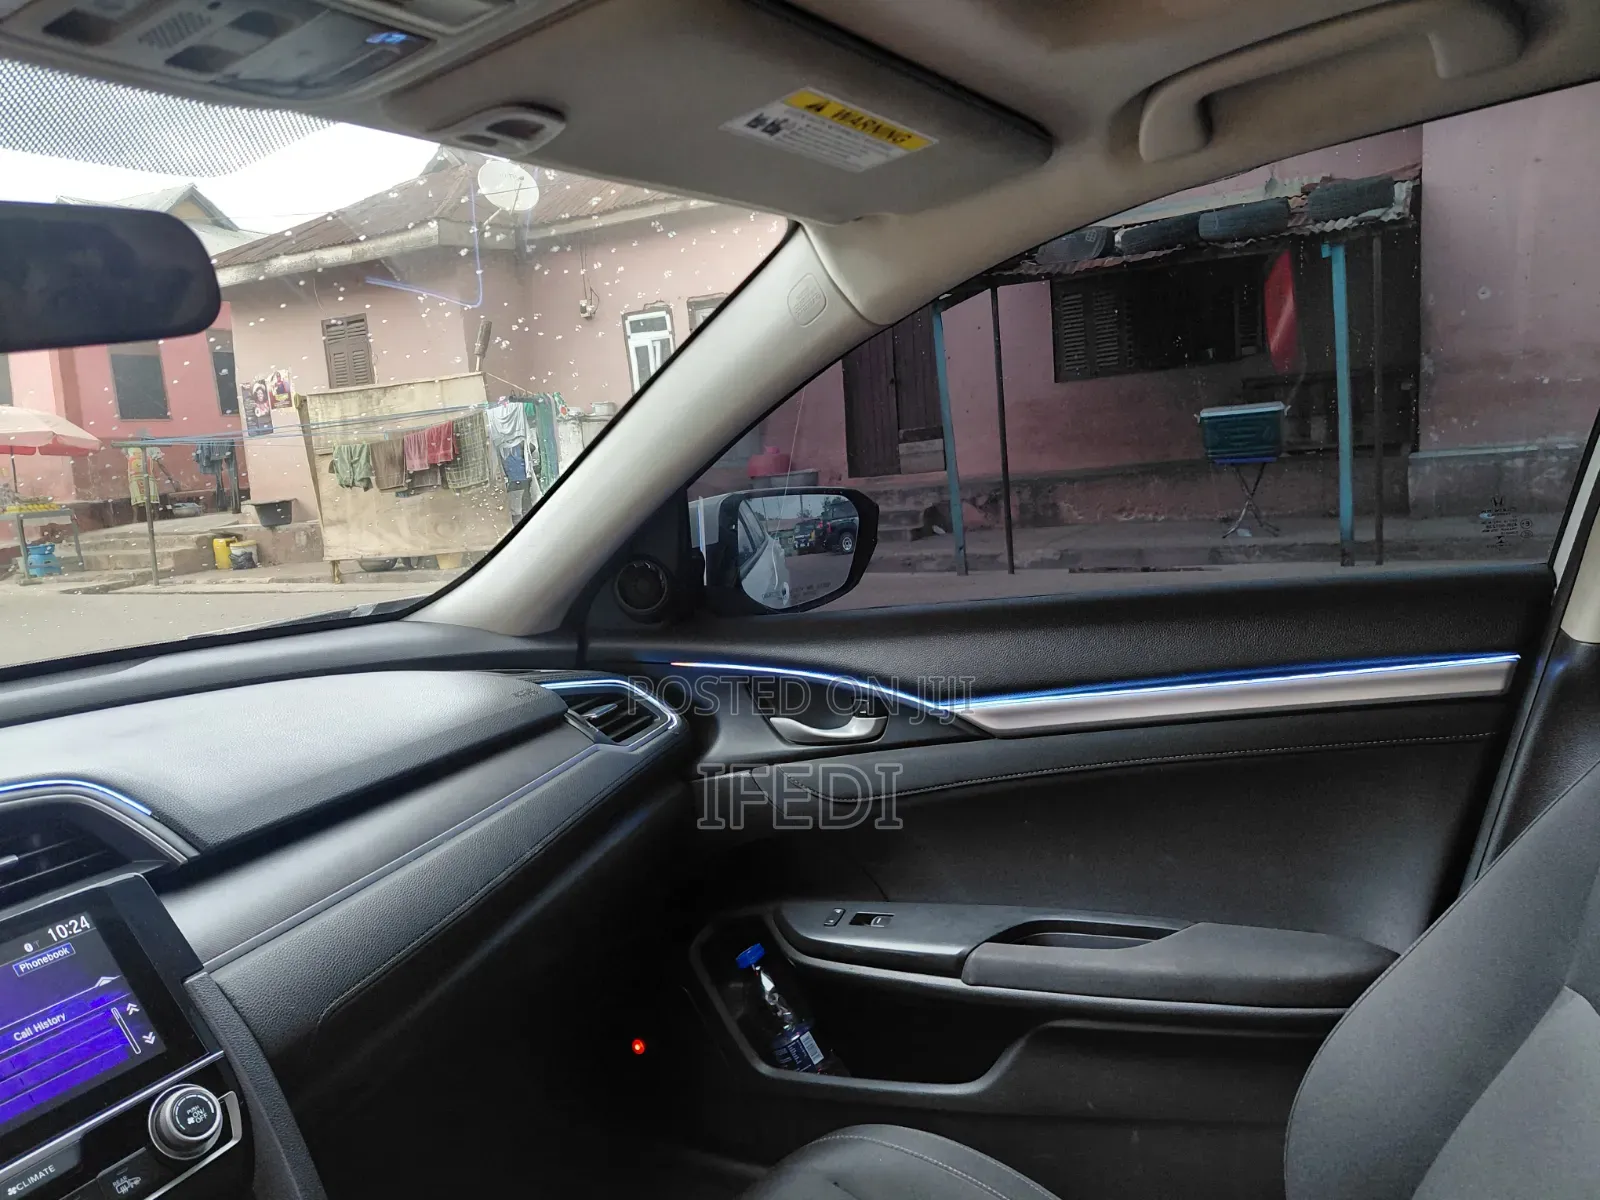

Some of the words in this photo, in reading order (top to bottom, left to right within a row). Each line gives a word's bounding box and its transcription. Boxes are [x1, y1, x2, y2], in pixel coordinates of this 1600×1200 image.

[47, 915, 91, 942] 10:24
[19, 946, 71, 973] Phonebook
[13, 1027, 33, 1041] Call
[33, 1013, 66, 1033] History
[195, 1112, 207, 1123] OFF
[16, 1164, 56, 1191] CLIMATE
[112, 1175, 128, 1187] REAR
